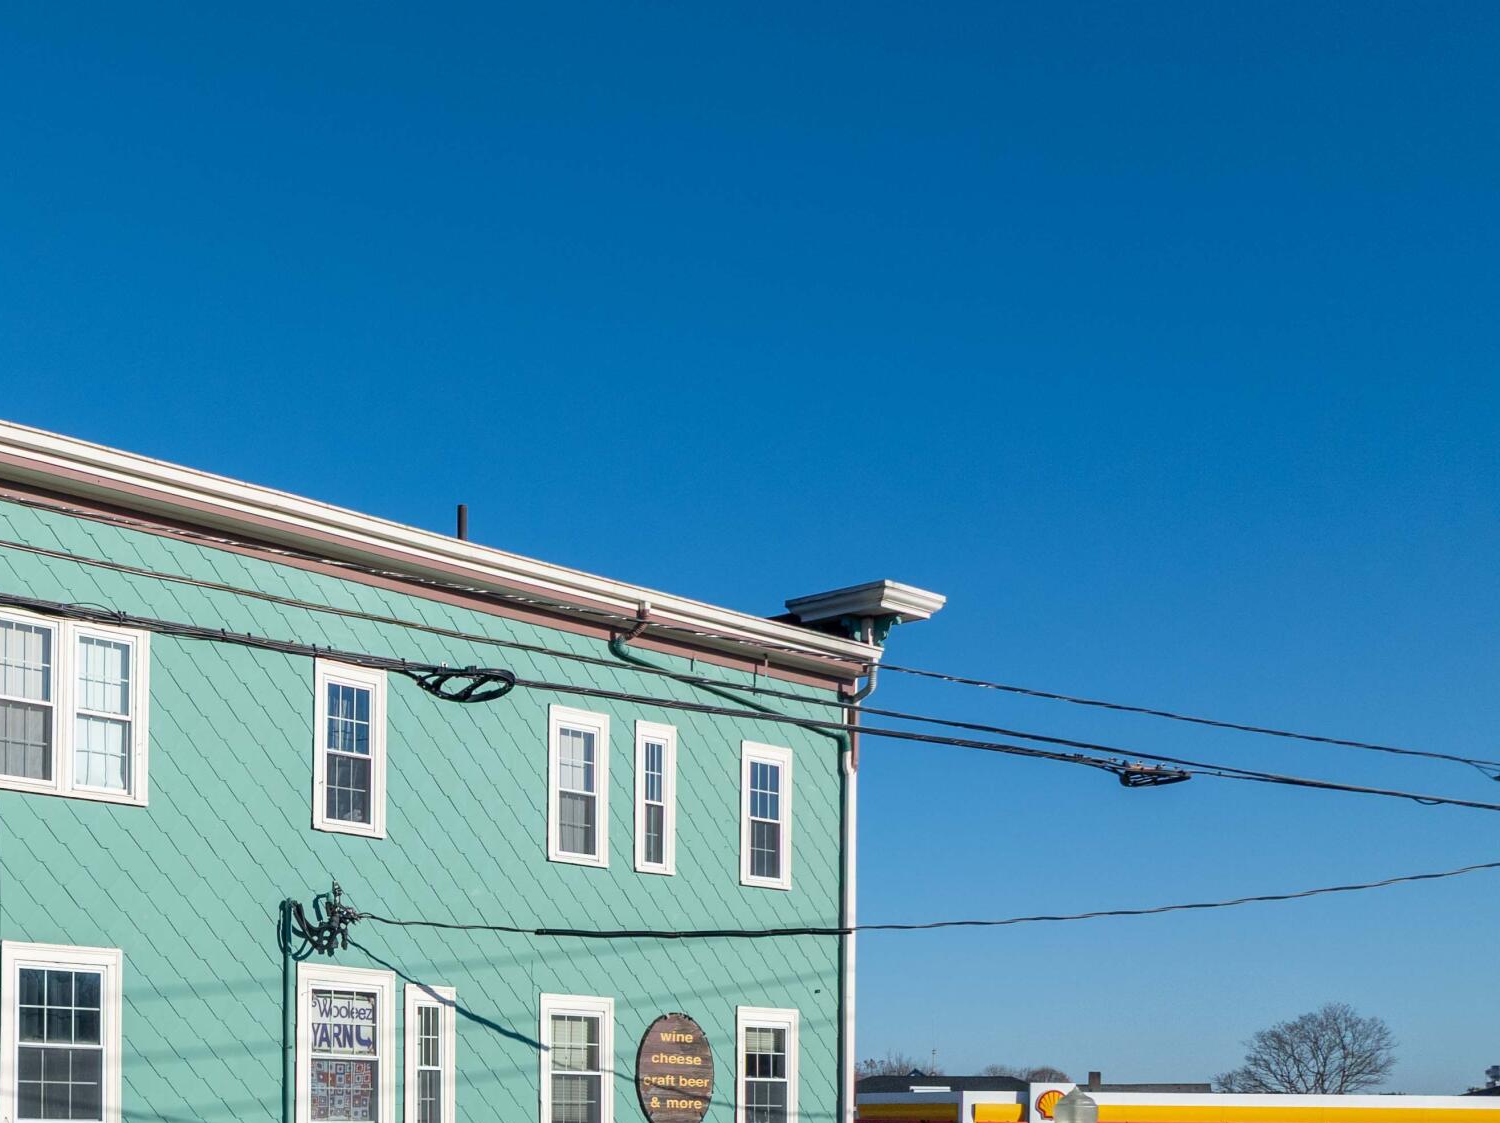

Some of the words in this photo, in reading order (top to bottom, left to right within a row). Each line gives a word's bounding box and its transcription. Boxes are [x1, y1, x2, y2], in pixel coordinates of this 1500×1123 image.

[311, 998, 373, 1021] Wooleez
[311, 1023, 354, 1049] YARN
[660, 1031, 694, 1043] wine
[651, 1053, 702, 1066] cheese
[643, 1075, 675, 1086] craft
[679, 1076, 710, 1087] beer
[650, 1096, 661, 1108] &
[666, 1099, 703, 1109] more
